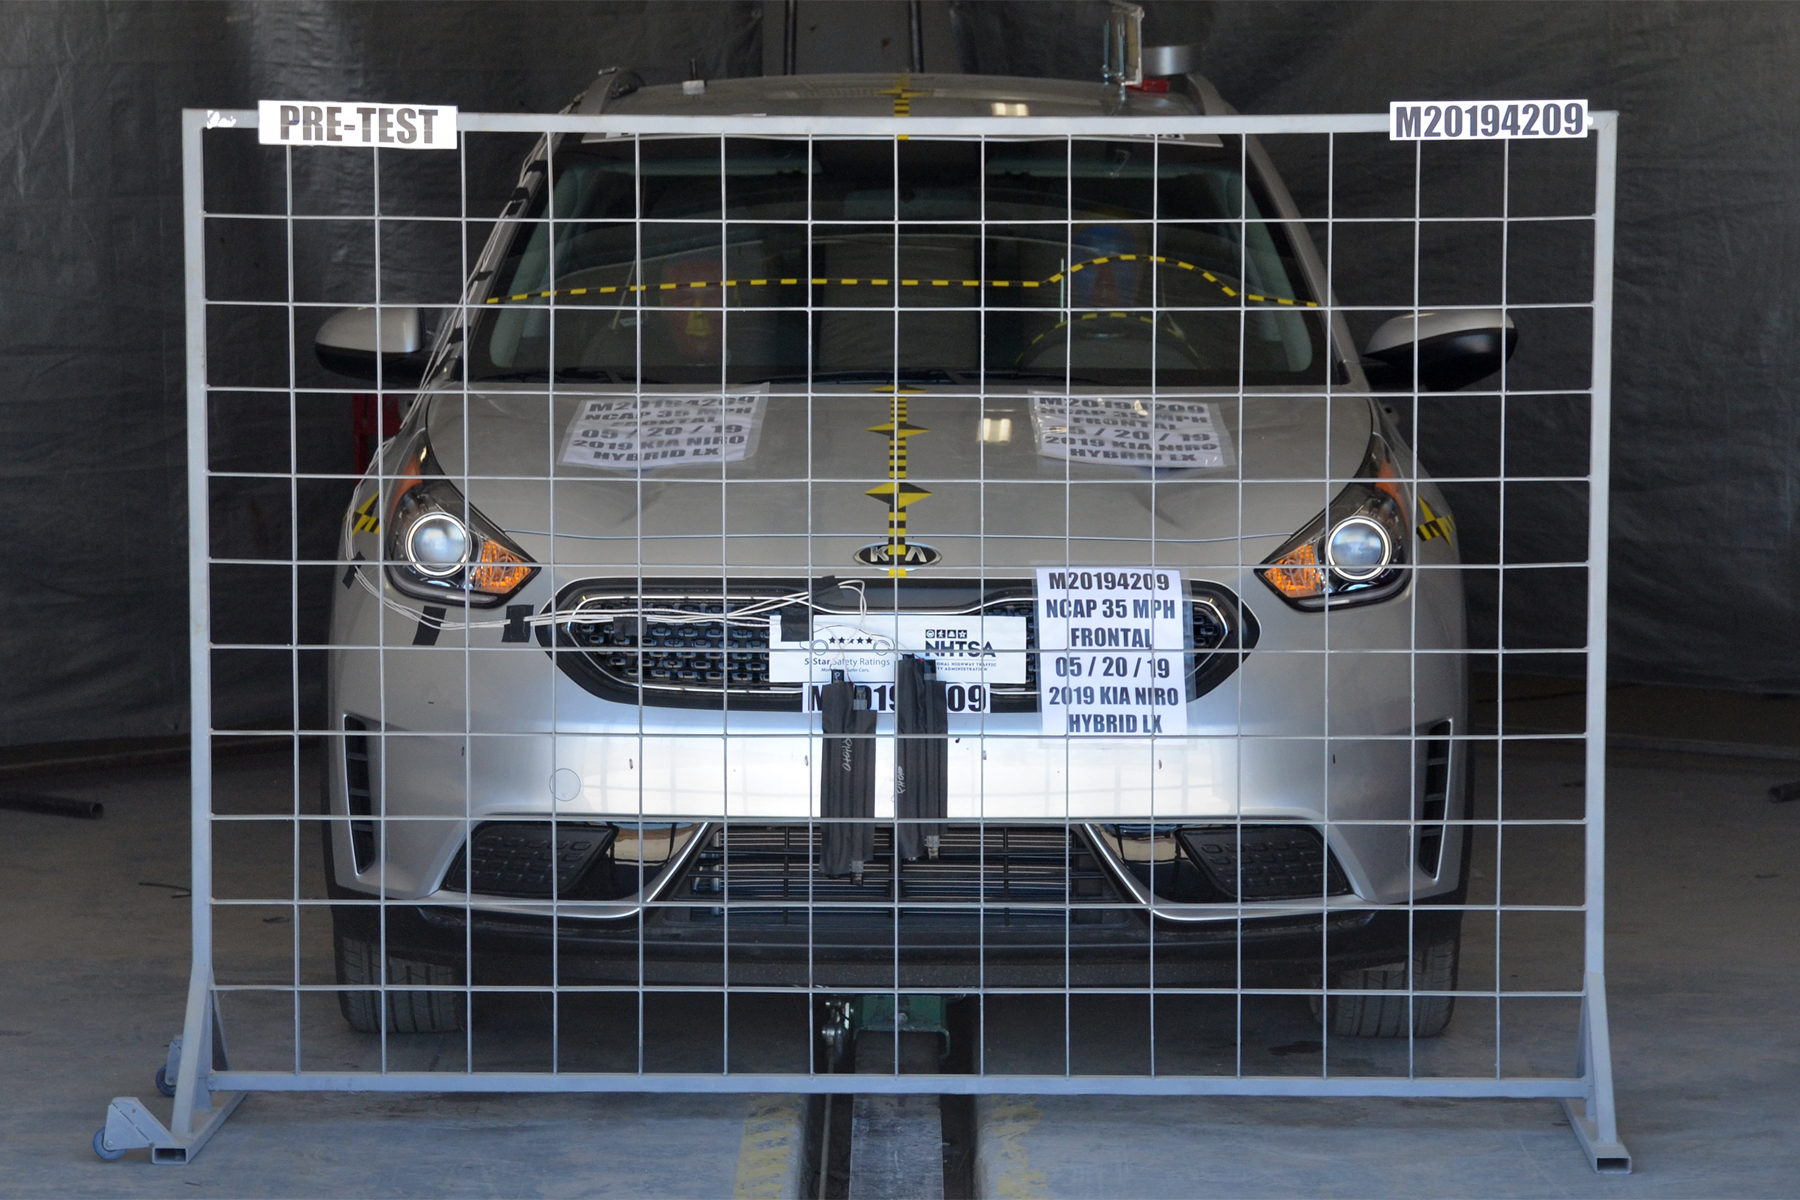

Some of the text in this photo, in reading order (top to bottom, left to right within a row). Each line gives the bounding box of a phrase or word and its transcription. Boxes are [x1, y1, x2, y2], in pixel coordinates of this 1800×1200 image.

[280, 105, 439, 144] PRE-TEST
[1395, 102, 1584, 138] M20194209
[646, 427, 683, 437] 20
[711, 424, 743, 433] 19
[1114, 429, 1151, 441] 20
[1180, 433, 1211, 441] 19
[572, 440, 634, 451] 2019
[640, 439, 680, 450] KIA
[1045, 436, 1106, 447] 2019
[1112, 440, 1153, 451] KIA
[593, 448, 719, 462] HYBRID LX
[1169, 453, 1197, 461] LX
[1048, 571, 1170, 591] M20194209
[1046, 598, 1176, 619] NCAP 35 MPH
[1070, 627, 1153, 648] FRONTAL
[925, 640, 997, 658] NHTSA
[859, 657, 891, 668] Ratings
[1055, 656, 1083, 678] 05
[1101, 656, 1128, 678] 20
[1146, 658, 1171, 679] 19
[1048, 686, 1180, 706] 2019 KIA NIRO
[1069, 714, 1163, 734] HYBRID LX
